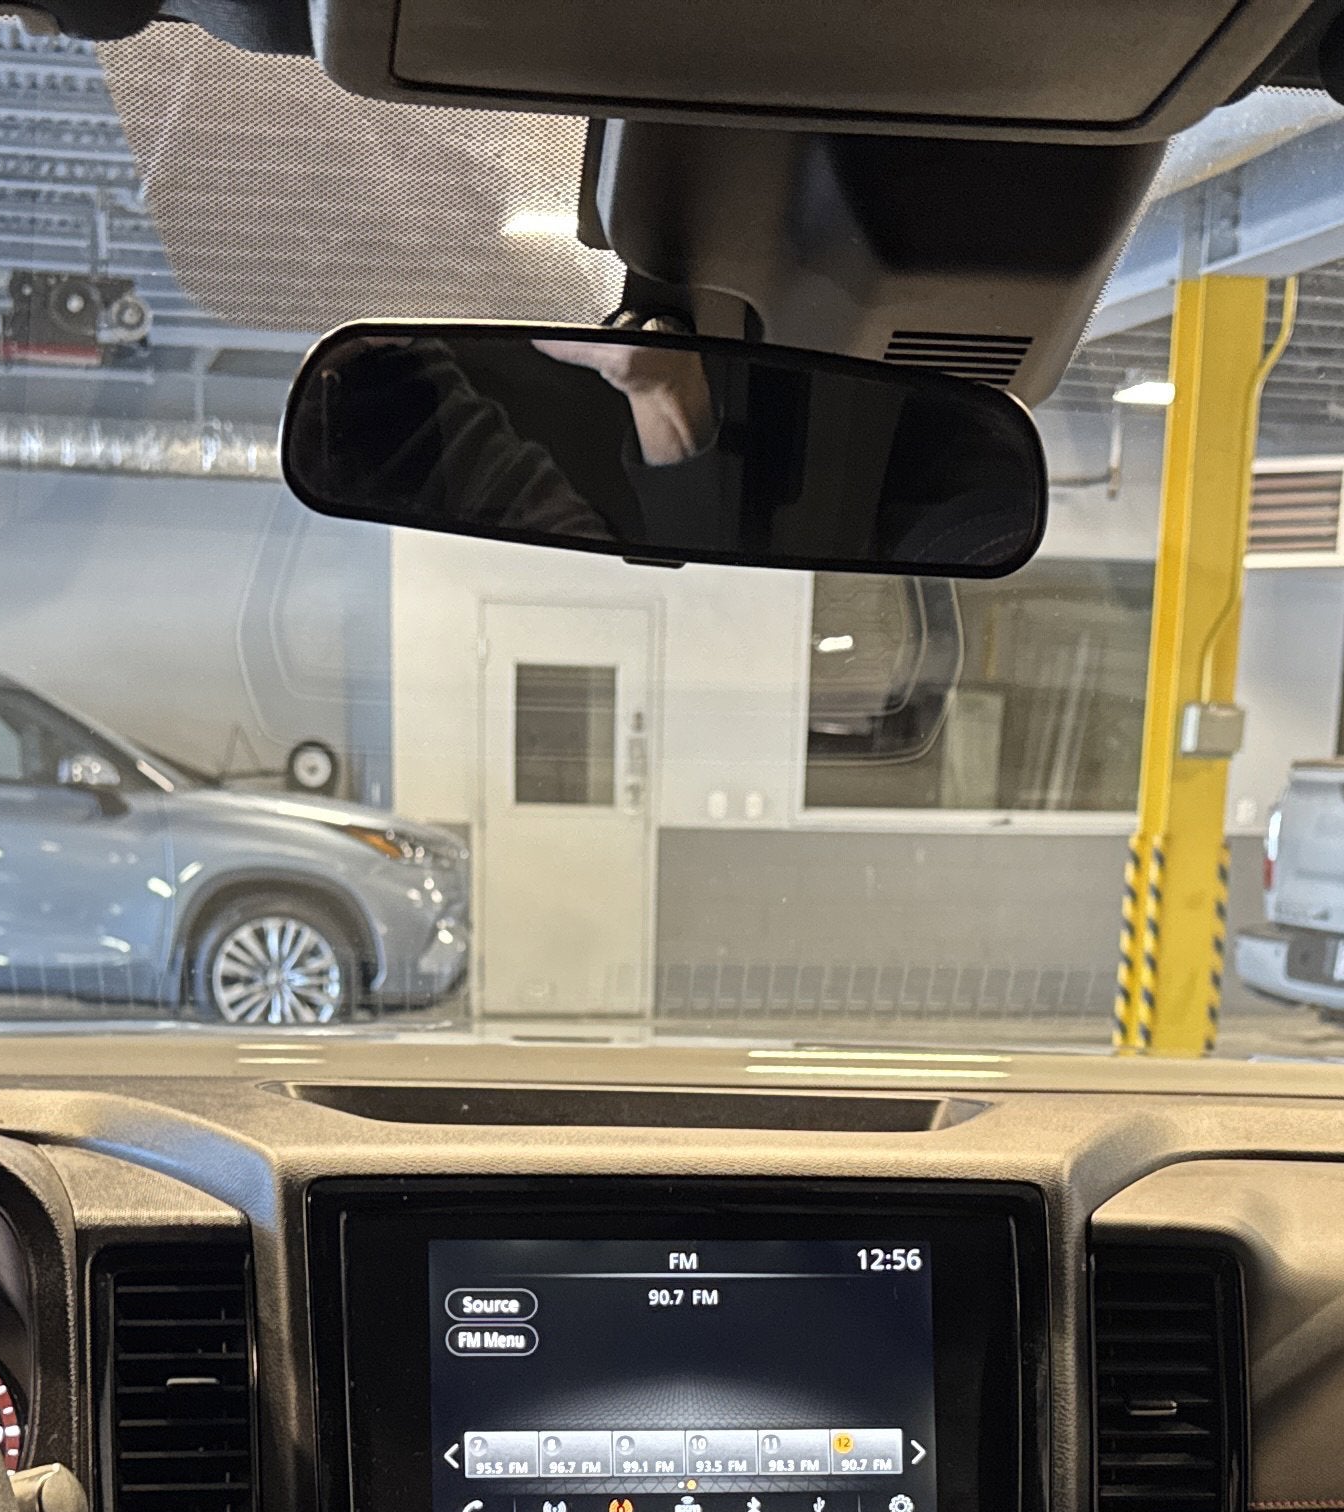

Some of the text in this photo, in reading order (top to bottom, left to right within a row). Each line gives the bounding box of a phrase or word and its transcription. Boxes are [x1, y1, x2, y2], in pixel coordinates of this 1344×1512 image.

[669, 1253, 698, 1270] FM
[856, 1248, 923, 1271] 12:56
[648, 1289, 719, 1306] 90.7 FM
[462, 1296, 520, 1315] Source
[457, 1332, 526, 1350] FM Menu
[474, 1439, 482, 1450] 7
[548, 1439, 557, 1450] 8
[622, 1438, 631, 1449] 9
[691, 1438, 707, 1450] 10
[764, 1438, 778, 1450] 11
[837, 1437, 851, 1449] 12
[476, 1461, 529, 1474] 95.5 FM
[549, 1461, 601, 1474] 96.7 FM
[622, 1460, 675, 1473] 99.1 FM
[695, 1460, 747, 1473] 93.5 FM
[768, 1459, 820, 1472] 98.3 FM
[841, 1459, 893, 1472] 90.7 FM
